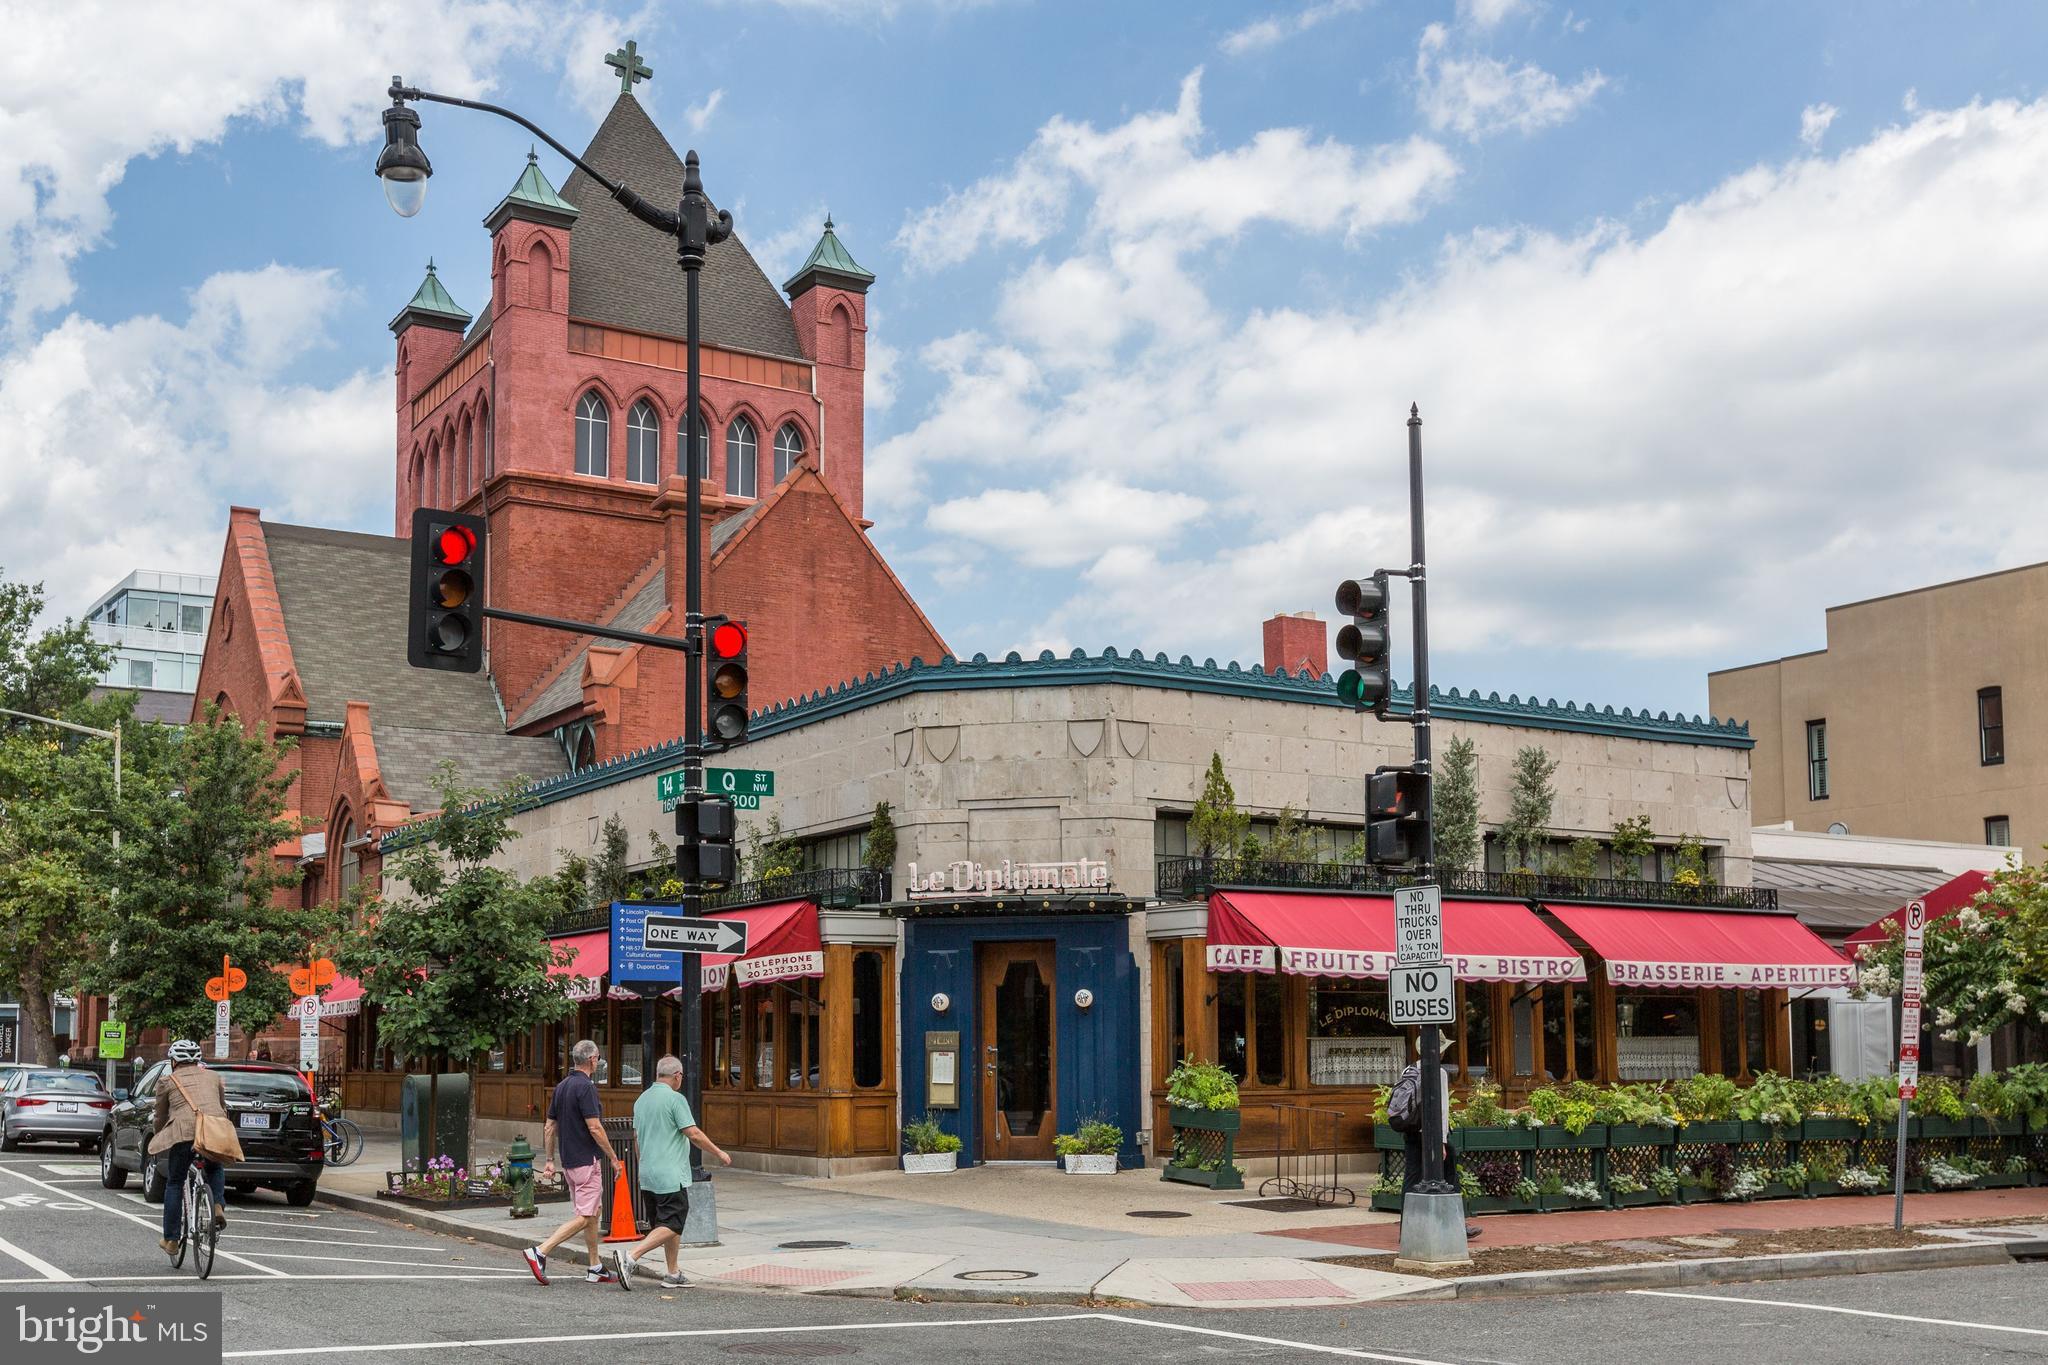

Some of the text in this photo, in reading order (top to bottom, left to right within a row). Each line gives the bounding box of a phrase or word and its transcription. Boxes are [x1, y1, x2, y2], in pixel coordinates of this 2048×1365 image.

[662, 776, 673, 795] 14
[722, 771, 767, 791] Q ST
[752, 783, 768, 792] NW
[908, 857, 1107, 897] Le Diplomate
[1410, 891, 1424, 903] NO
[1405, 903, 1431, 915] THRU
[1399, 914, 1438, 928] TRUCKS
[650, 928, 717, 941] ONE WAY
[1405, 929, 1432, 941] OVER
[1417, 942, 1439, 950] TON
[1400, 951, 1439, 961] CAPACITY
[1290, 951, 1374, 971] FRUITS
[1498, 959, 1574, 976] BISTRO
[747, 963, 813, 979] 20 23 32 33 33
[1614, 964, 1724, 982] BRASSERIE
[1406, 972, 1438, 992] NO
[1395, 998, 1449, 1017] BUSES
[1319, 1013, 1333, 1027] LE
